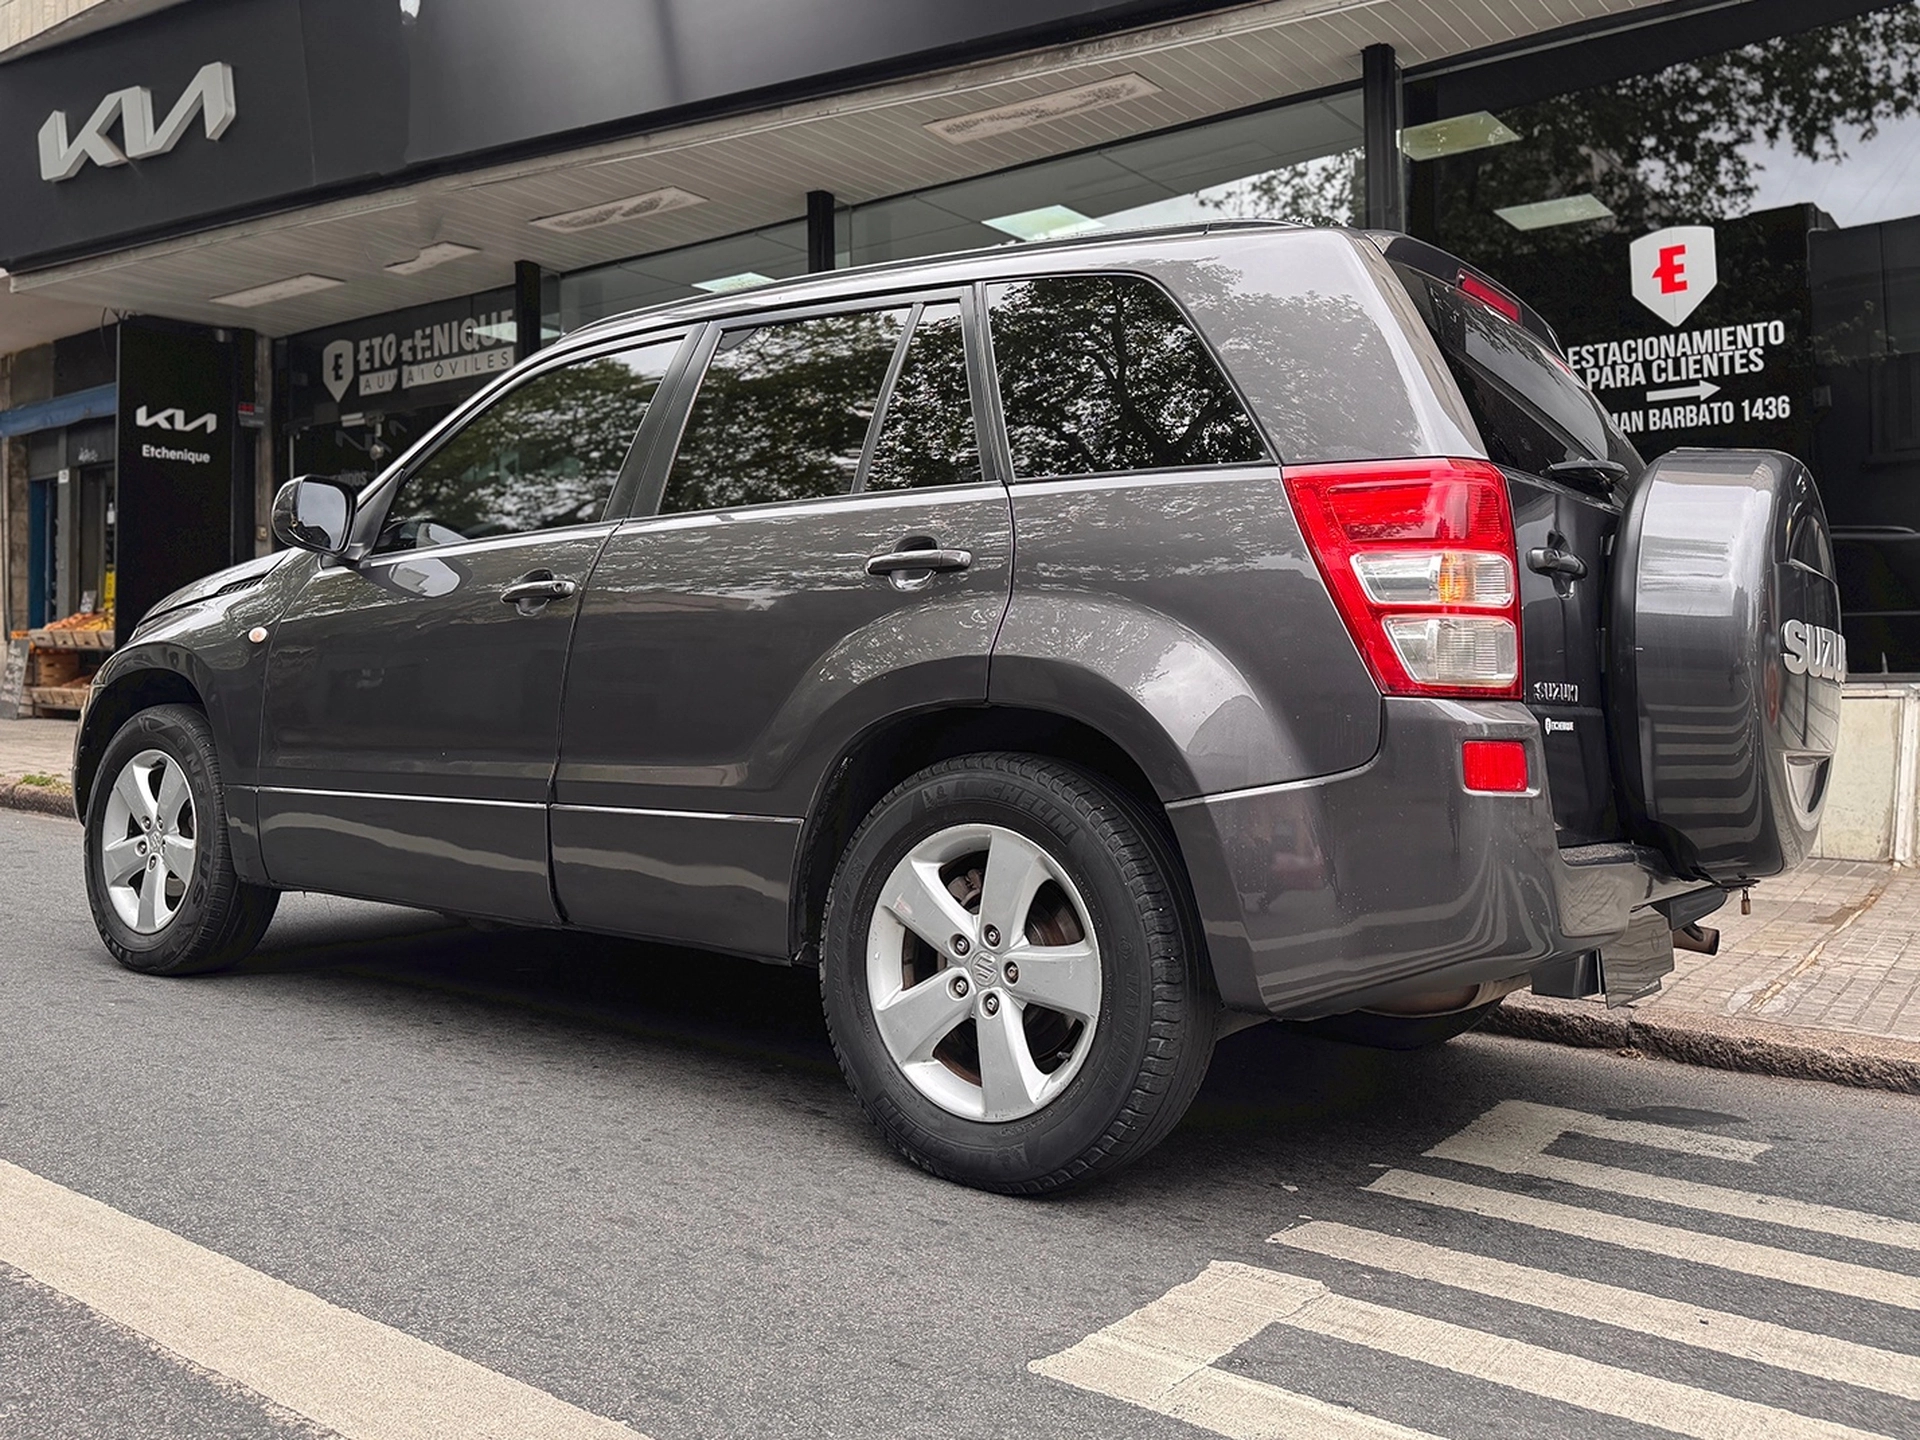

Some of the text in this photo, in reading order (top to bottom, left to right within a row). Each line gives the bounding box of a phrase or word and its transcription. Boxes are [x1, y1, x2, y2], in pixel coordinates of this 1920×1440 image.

[1567, 320, 1785, 371] ESTACIONAMIENTO
[1586, 348, 1764, 392] PARA CLIENTES
[1649, 401, 1734, 431] BARBATO
[1741, 395, 1790, 422] 1436
[142, 444, 210, 464] Etchenique
[1533, 682, 1579, 703] SUZUKI
[953, 781, 1078, 838] CHELIN
